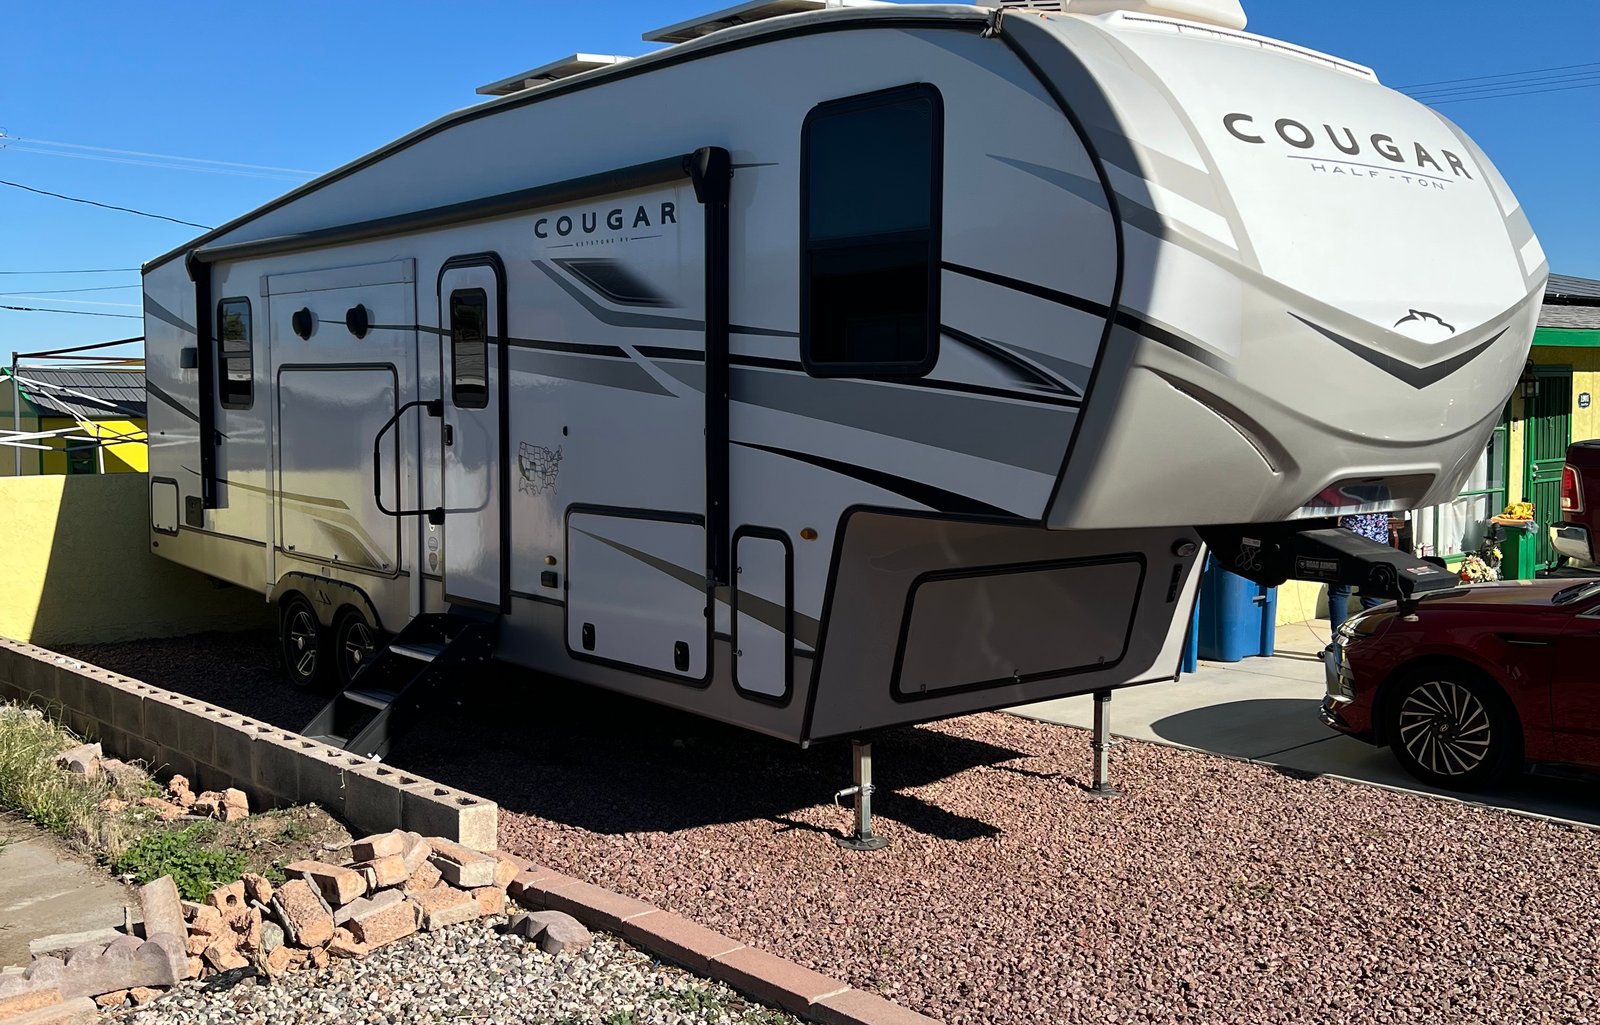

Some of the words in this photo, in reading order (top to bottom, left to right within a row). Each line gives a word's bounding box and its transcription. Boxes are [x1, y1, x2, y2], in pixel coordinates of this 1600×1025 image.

[1223, 112, 1474, 180] COUGAR
[1311, 163, 1446, 191] HALF-TON
[534, 202, 677, 239] COUGAR
